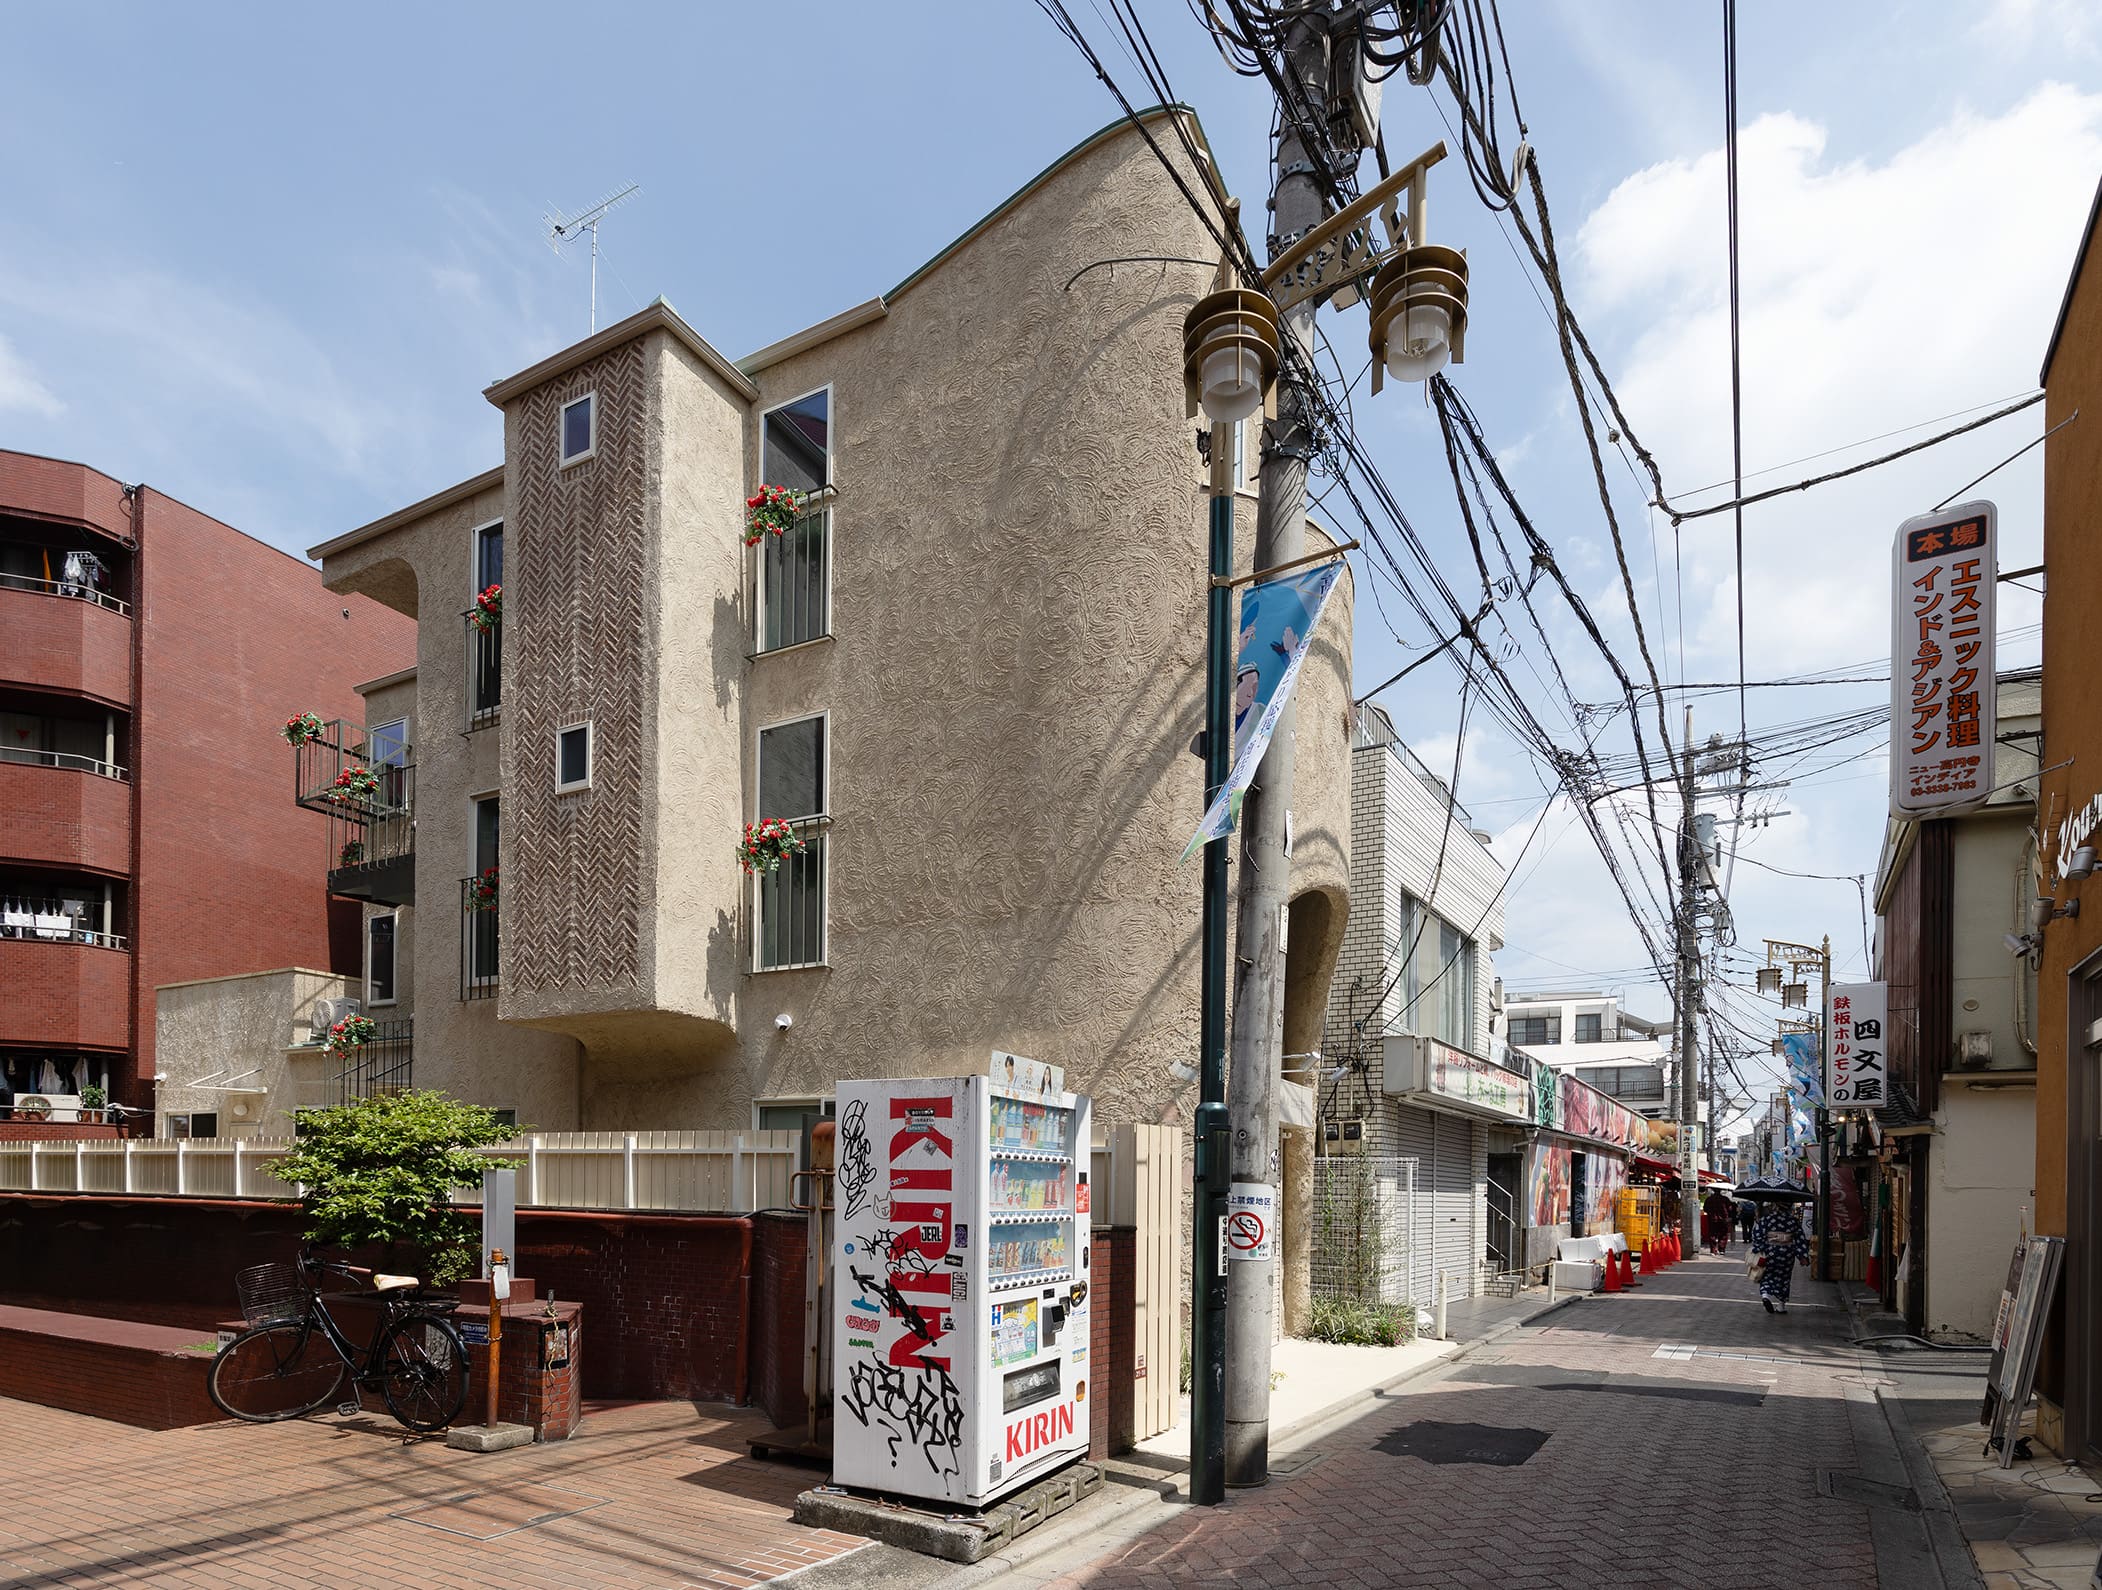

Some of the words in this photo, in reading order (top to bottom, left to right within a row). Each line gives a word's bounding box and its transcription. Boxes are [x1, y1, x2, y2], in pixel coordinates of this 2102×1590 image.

[1916, 523, 1978, 554] 本場
[1911, 566, 1943, 755] インド&アジアン
[1947, 558, 1982, 748] エスニック料理
[1833, 996, 1850, 1101] 鉄板ホルモンの
[1852, 1019, 1882, 1101] 四文屋
[889, 1096, 953, 1373] KIRIN
[1006, 1401, 1074, 1463] KIRIN
